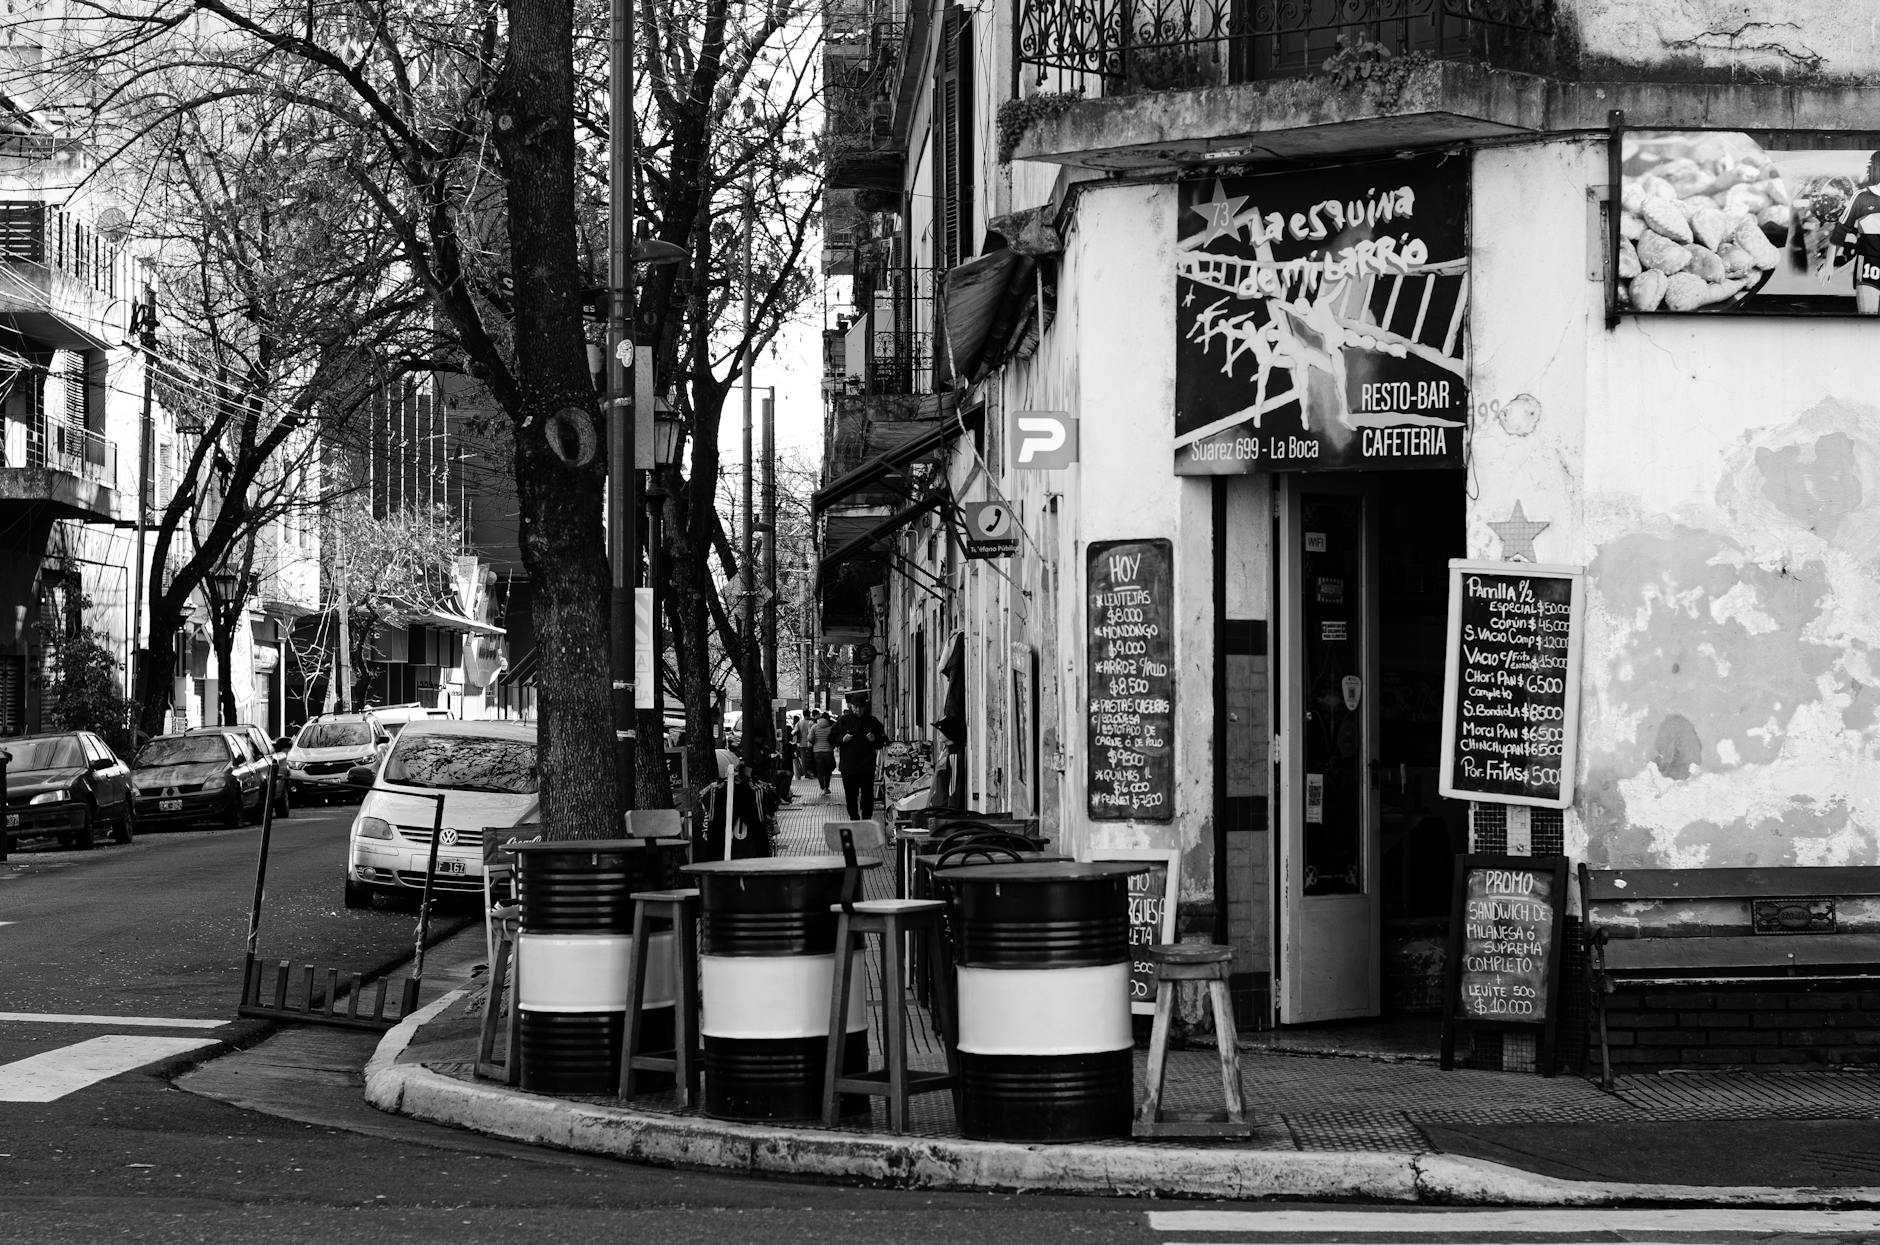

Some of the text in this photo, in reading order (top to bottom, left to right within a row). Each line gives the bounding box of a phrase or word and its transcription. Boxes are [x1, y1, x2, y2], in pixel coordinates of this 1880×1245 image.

[1213, 202, 1230, 227] 73
[1862, 262, 1880, 280] 10
[1237, 263, 1274, 299] de
[1361, 381, 1450, 411] RESTO-BAR
[1191, 438, 1233, 461] Suarez
[1235, 437, 1259, 460] 699
[1270, 438, 1286, 459] La
[1289, 437, 1319, 458] Boca
[1362, 428, 1447, 456] CAFETERIA
[1308, 536, 1325, 548] WIFI
[1109, 553, 1141, 583] HOY
[1104, 590, 1151, 606] LENTEJAS
[1102, 623, 1158, 639] MONDONGO
[1103, 658, 1137, 675] ARROZ
[1100, 698, 1169, 713] PASTAS CASERAS
[1521, 702, 1564, 721] $8500
[1102, 724, 1156, 737] ESTOFADO DE
[1521, 726, 1564, 741] $6500
[1094, 736, 1123, 747] CARNE
[1135, 738, 1143, 747] DE
[1145, 737, 1164, 747] POLLO
[1103, 766, 1139, 782] QUILMES
[1485, 870, 1534, 895] PROMO
[1468, 901, 1548, 922] SANDWICH DE
[1466, 922, 1523, 940] MILANESA
[1483, 941, 1542, 956] SUPREMA
[1467, 956, 1532, 973] COMPLETO
[1513, 986, 1536, 998] 500
